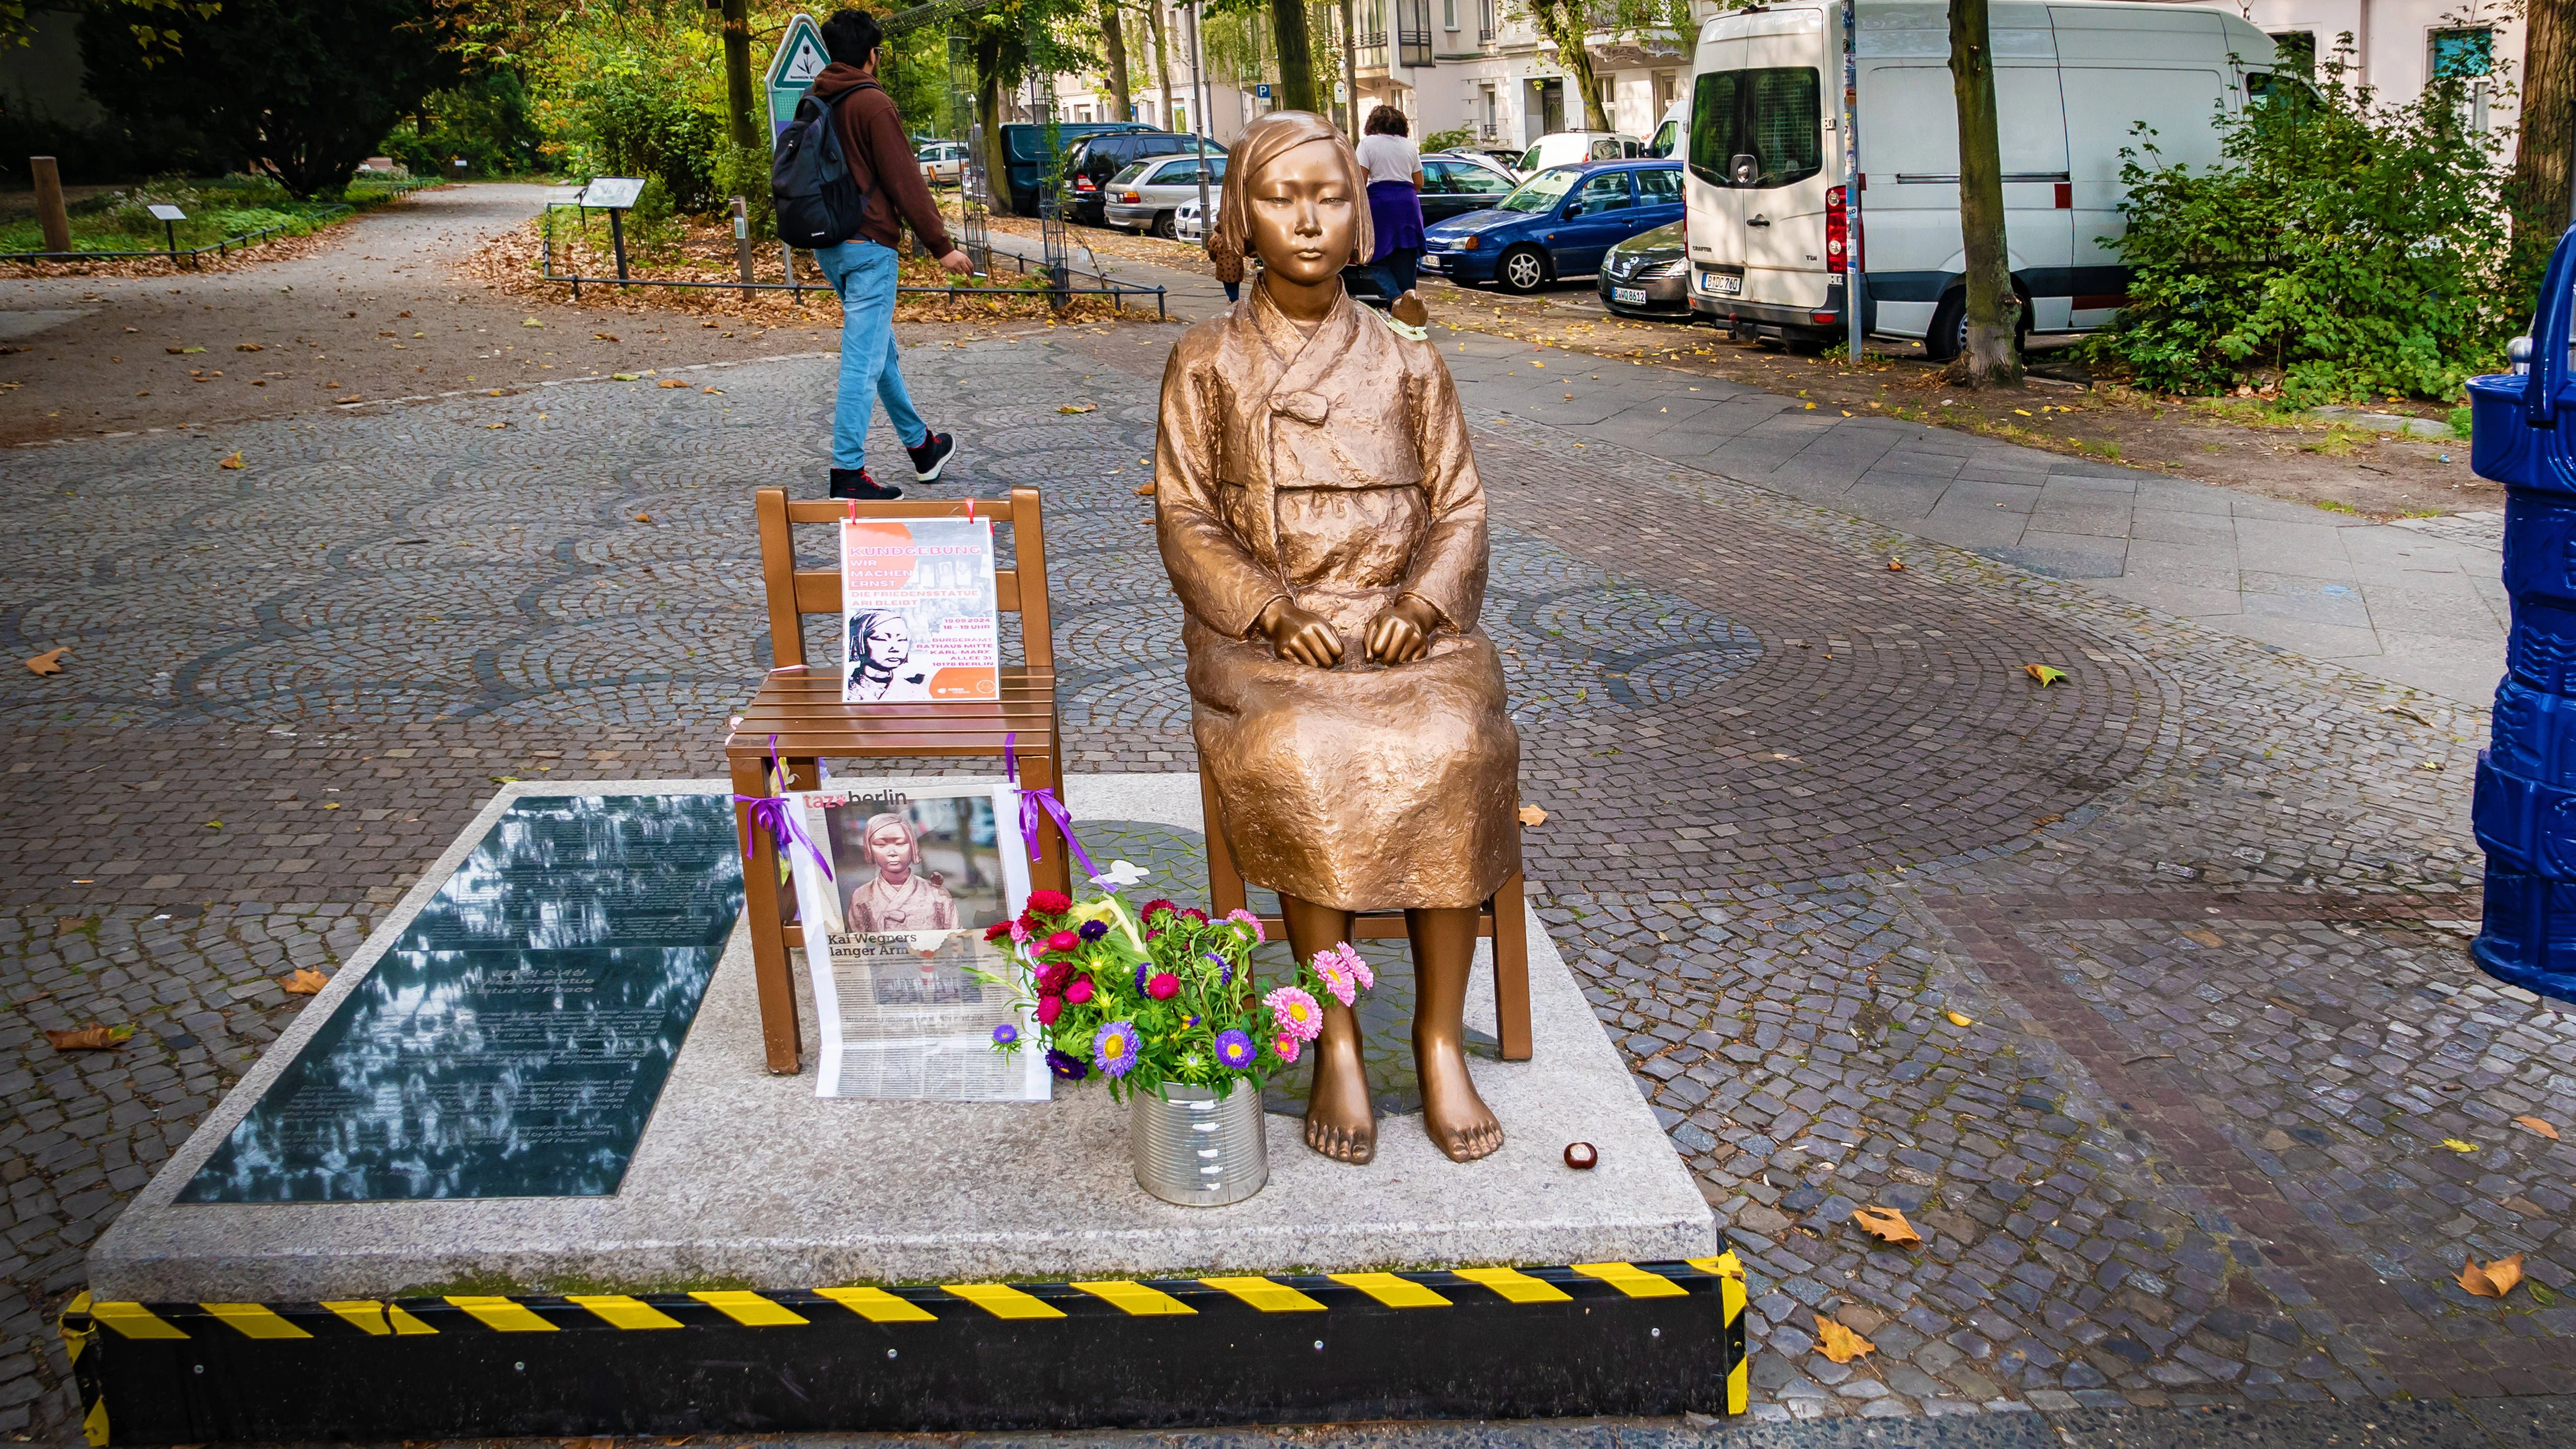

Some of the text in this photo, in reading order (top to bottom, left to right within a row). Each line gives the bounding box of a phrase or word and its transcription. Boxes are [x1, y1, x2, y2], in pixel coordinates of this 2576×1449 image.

[1259, 86, 1267, 97] P
[1725, 278, 1738, 290] 760
[1629, 291, 1644, 302] 8612
[849, 546, 982, 557] KUNDGEBUNG
[803, 789, 908, 809] taz berlin
[827, 933, 917, 946] Kai Wegners
[830, 946, 910, 958] langer Arm
